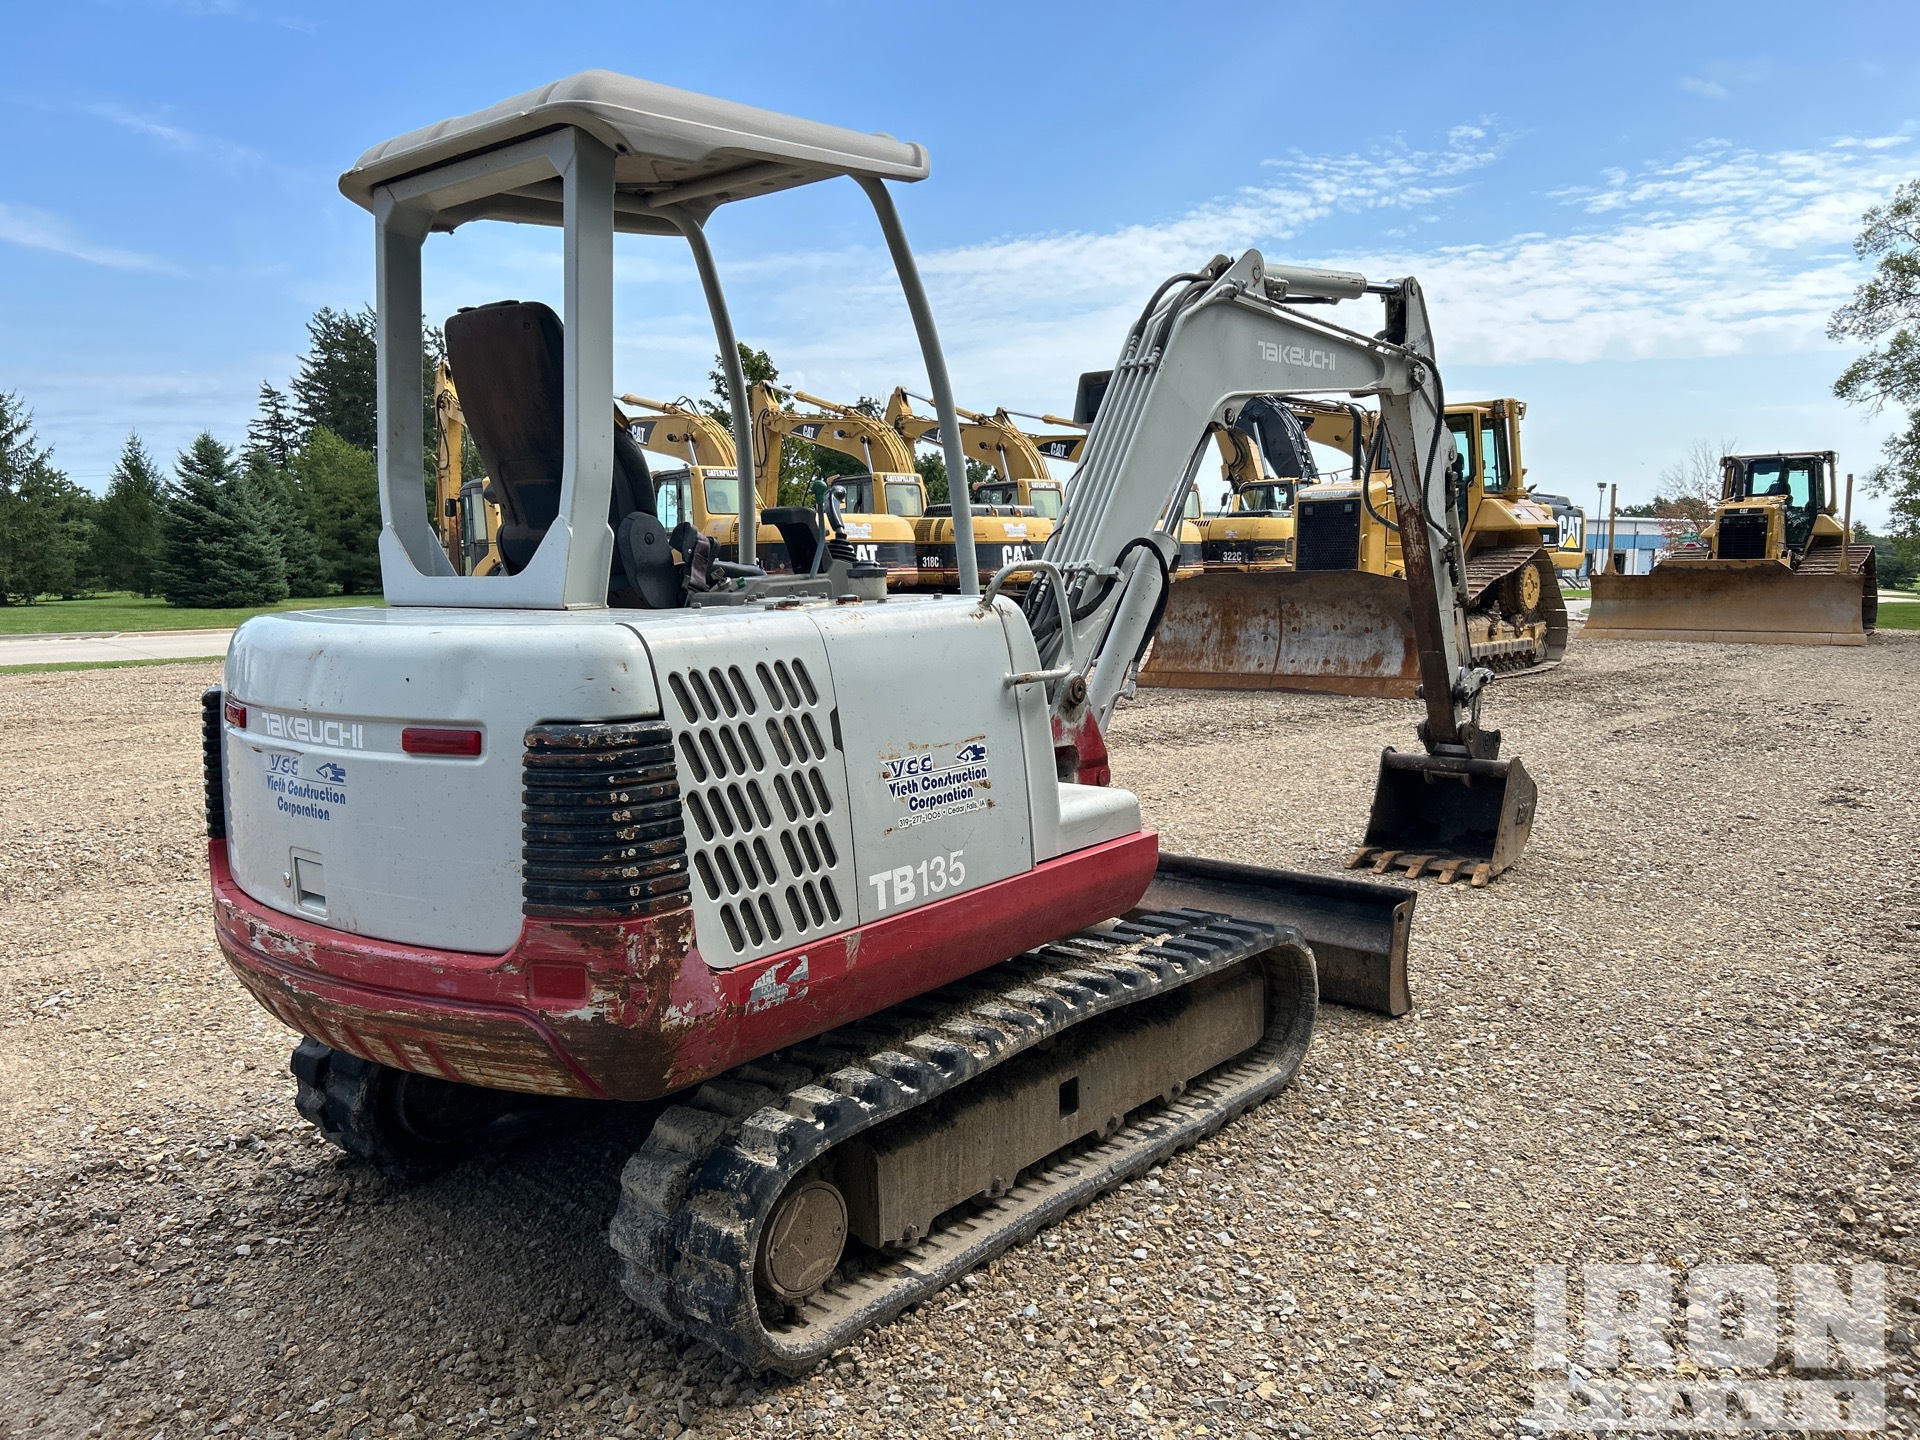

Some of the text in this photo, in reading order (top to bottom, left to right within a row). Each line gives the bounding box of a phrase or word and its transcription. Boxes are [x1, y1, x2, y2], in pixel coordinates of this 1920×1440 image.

[632, 425, 646, 443] CAT
[802, 425, 815, 438] CAT
[1050, 442, 1067, 456] CAT
[1557, 514, 1582, 549] CAT
[848, 544, 878, 561] AT
[922, 556, 940, 568] 318C
[1222, 551, 1242, 561] 322C
[270, 753, 298, 776] VCC
[885, 755, 932, 777] VCC
[266, 774, 346, 805] Vieth Construction
[888, 767, 987, 798] Vieth Construction
[277, 796, 330, 821] Corporation
[908, 786, 974, 811] Corporation
[899, 812, 942, 828] 319-277-1006
[947, 806, 965, 816] Cedar
[979, 800, 986, 808] IA
[869, 850, 966, 911] TB135
